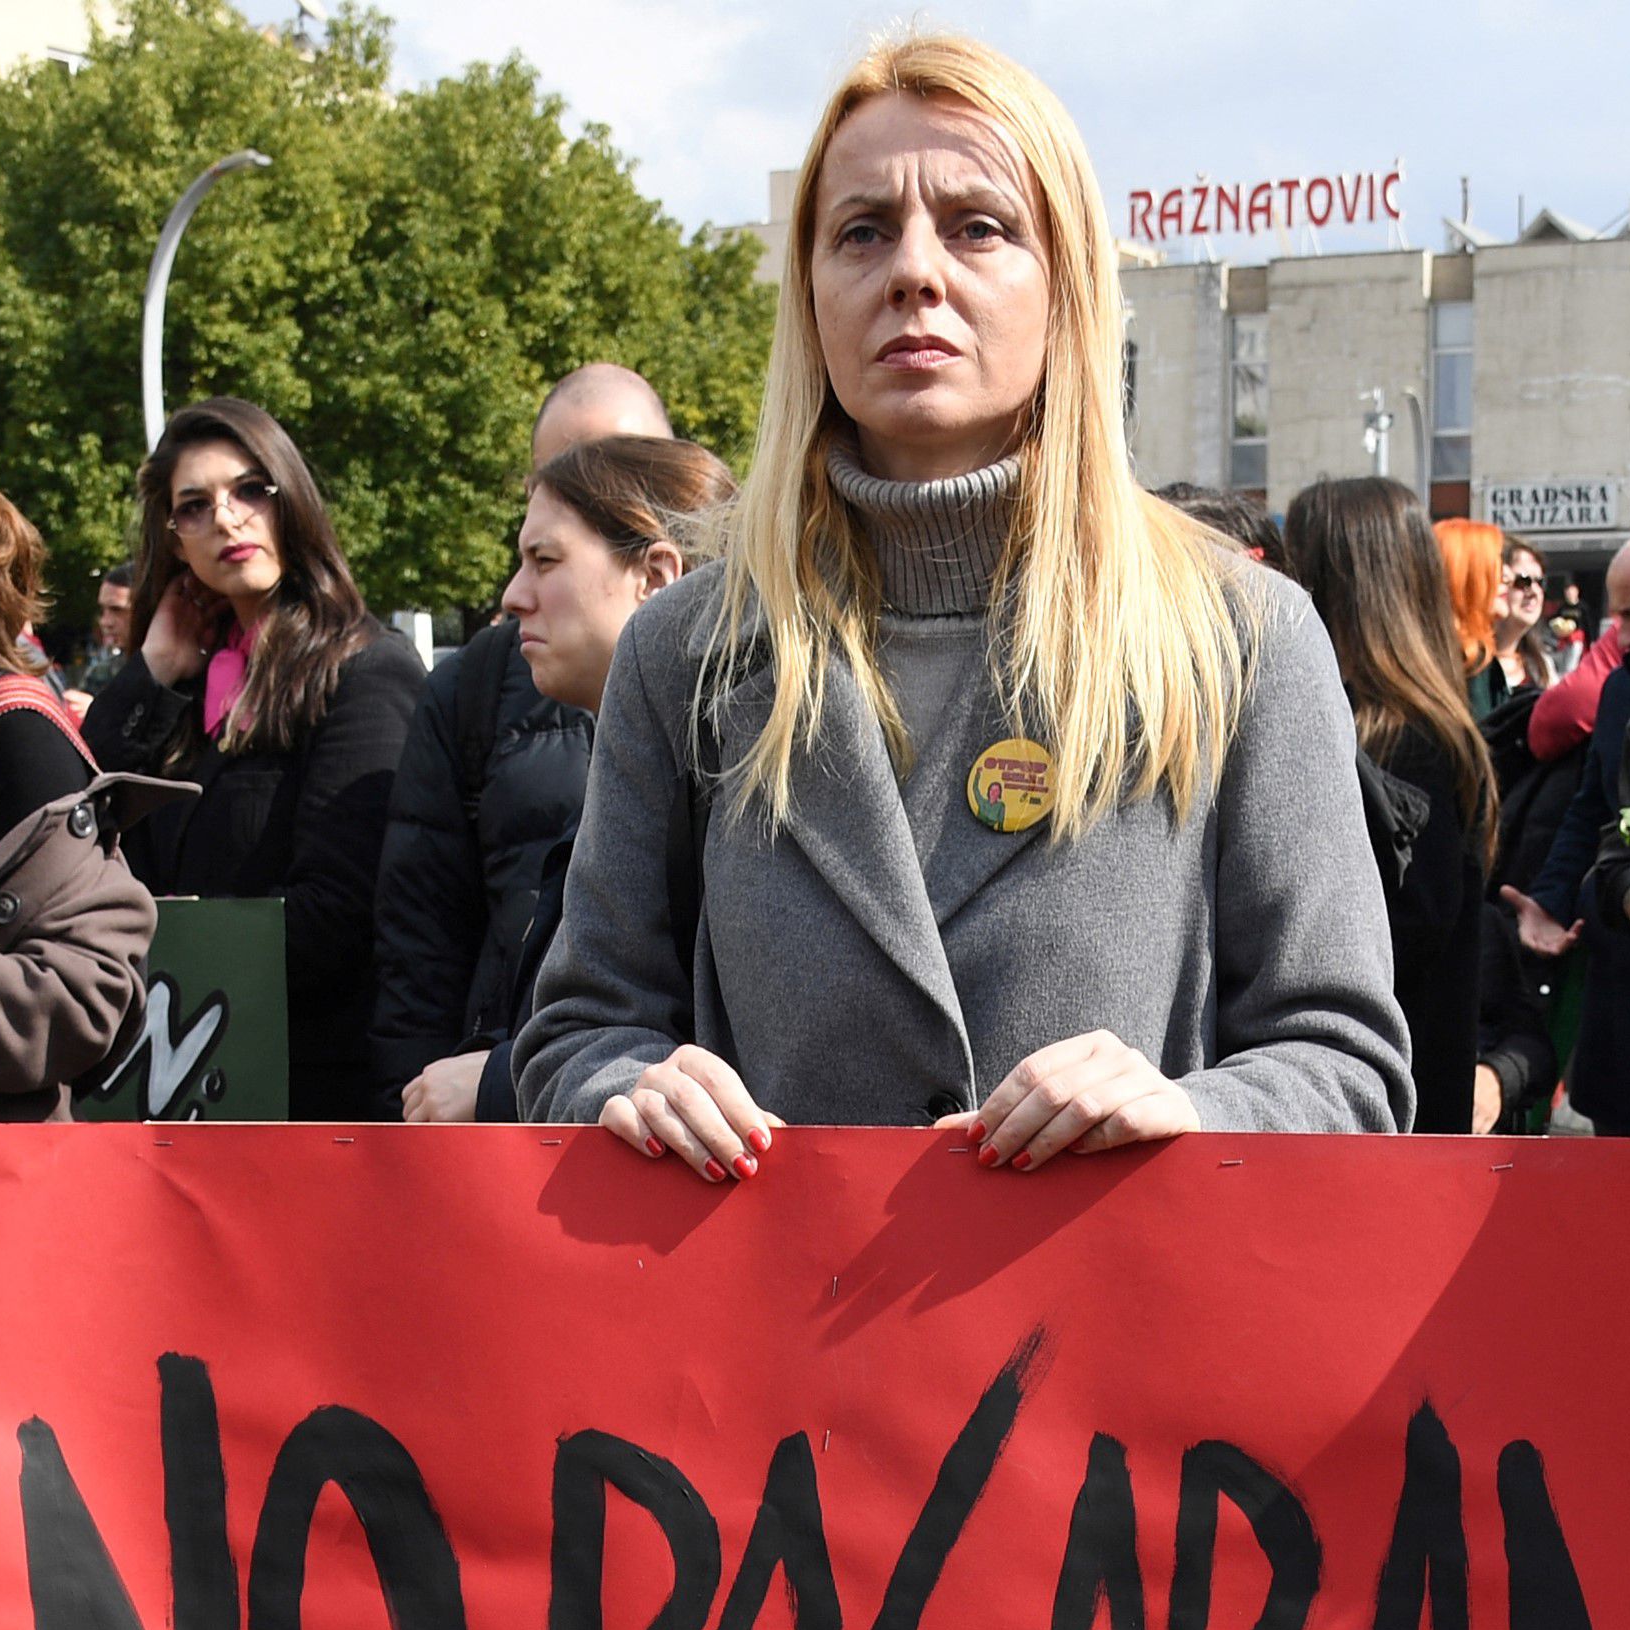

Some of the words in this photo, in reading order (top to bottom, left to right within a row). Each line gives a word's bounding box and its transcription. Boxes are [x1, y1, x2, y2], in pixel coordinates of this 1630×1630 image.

[1129, 157, 1405, 241] RAŽNATOVIĆ
[1491, 485, 1608, 505] GRADSKA
[1492, 505, 1608, 526] KNJIŽARA
